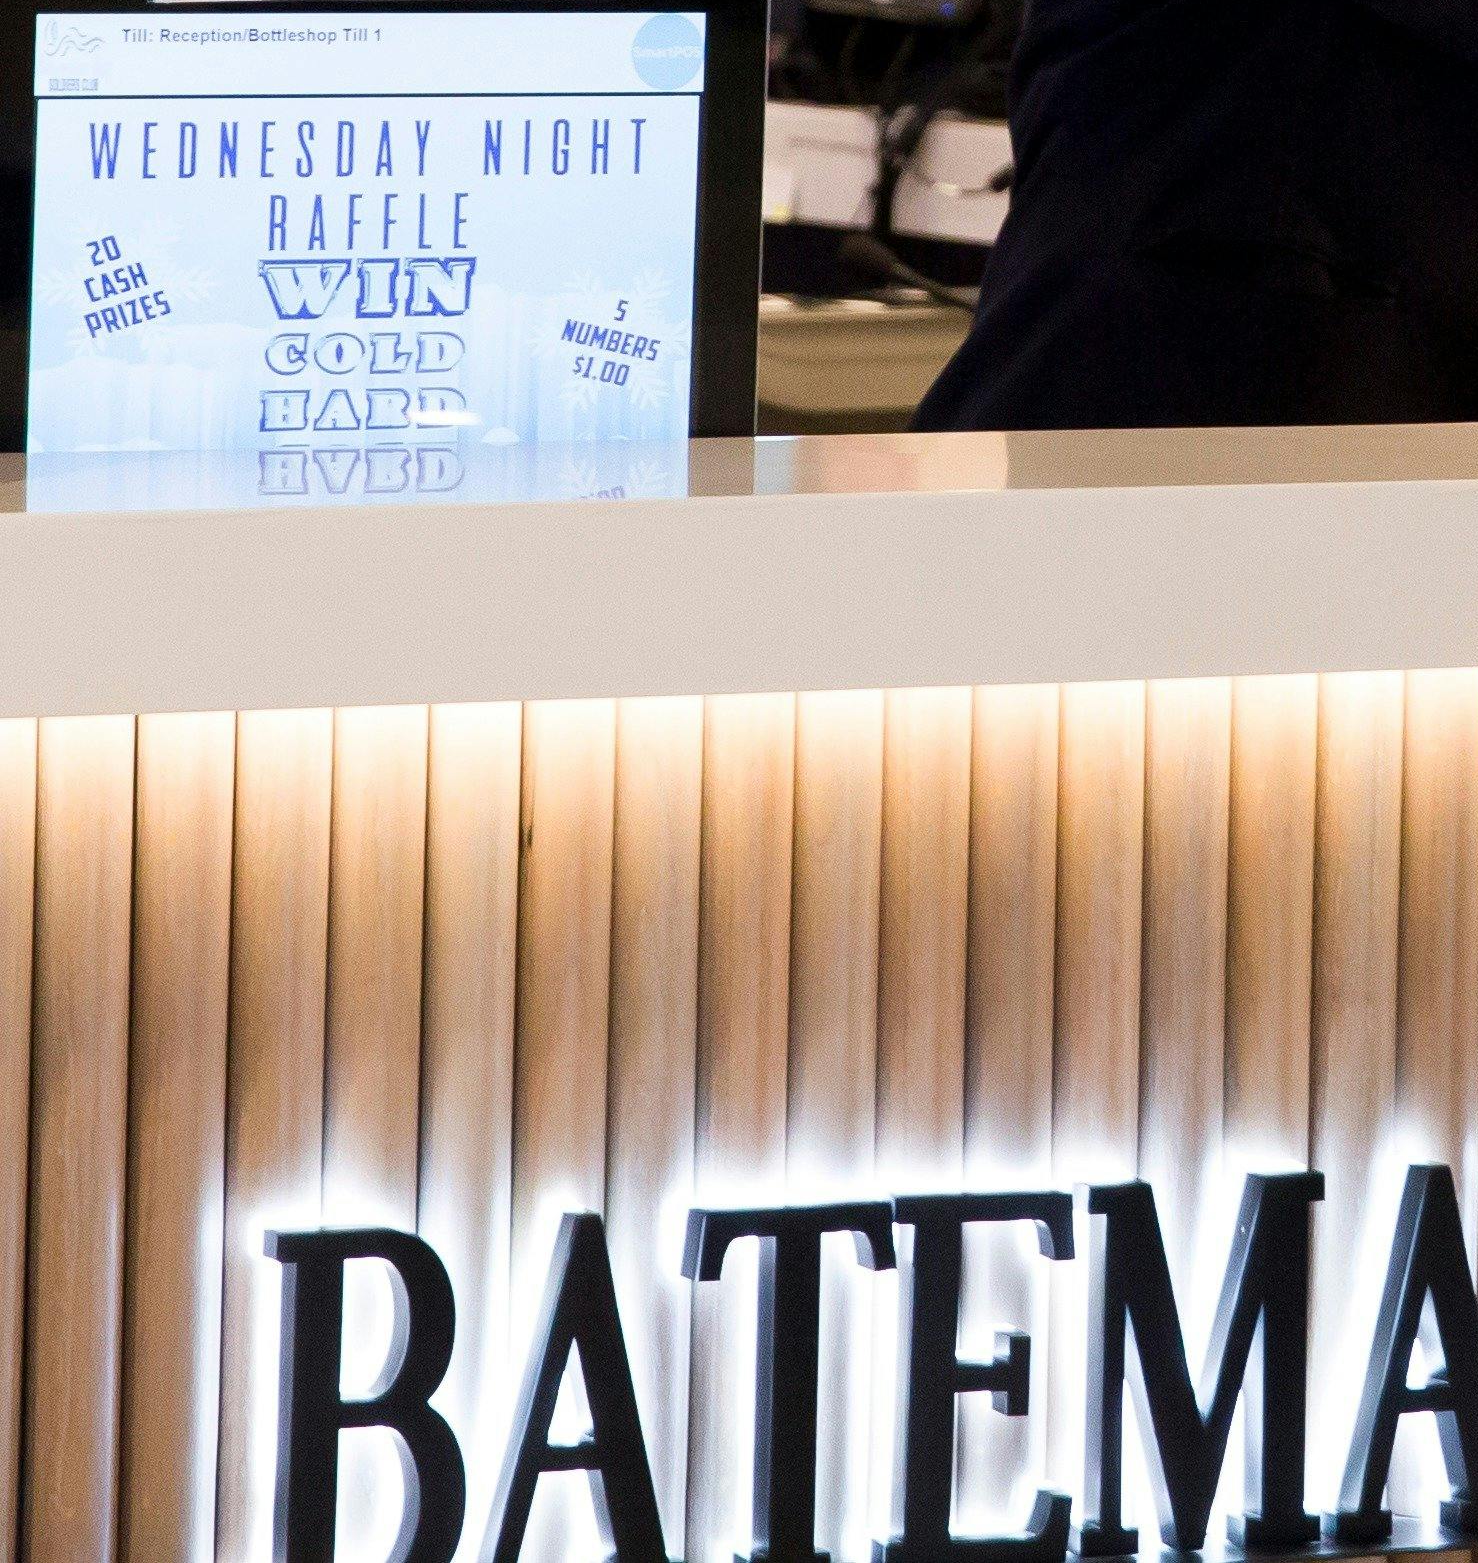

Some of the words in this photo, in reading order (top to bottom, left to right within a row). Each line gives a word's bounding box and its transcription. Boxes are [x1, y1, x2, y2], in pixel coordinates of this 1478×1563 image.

[122, 28, 154, 43] Till:
[160, 27, 337, 45] Reception/Bottleshop
[344, 28, 369, 42] Till
[374, 28, 383, 42] 1
[89, 119, 431, 179] WEDNESDAY
[483, 118, 647, 176] NIGHT
[268, 193, 469, 252] RAFFLE
[86, 235, 122, 267] 20
[83, 262, 149, 304] CASH
[257, 256, 477, 320] WIN
[83, 290, 172, 339] PRIZES
[613, 299, 630, 322] 5
[264, 332, 467, 375] COLD
[560, 318, 661, 362] NUMBERS
[571, 355, 632, 388] $1.00
[258, 387, 467, 433] HARD
